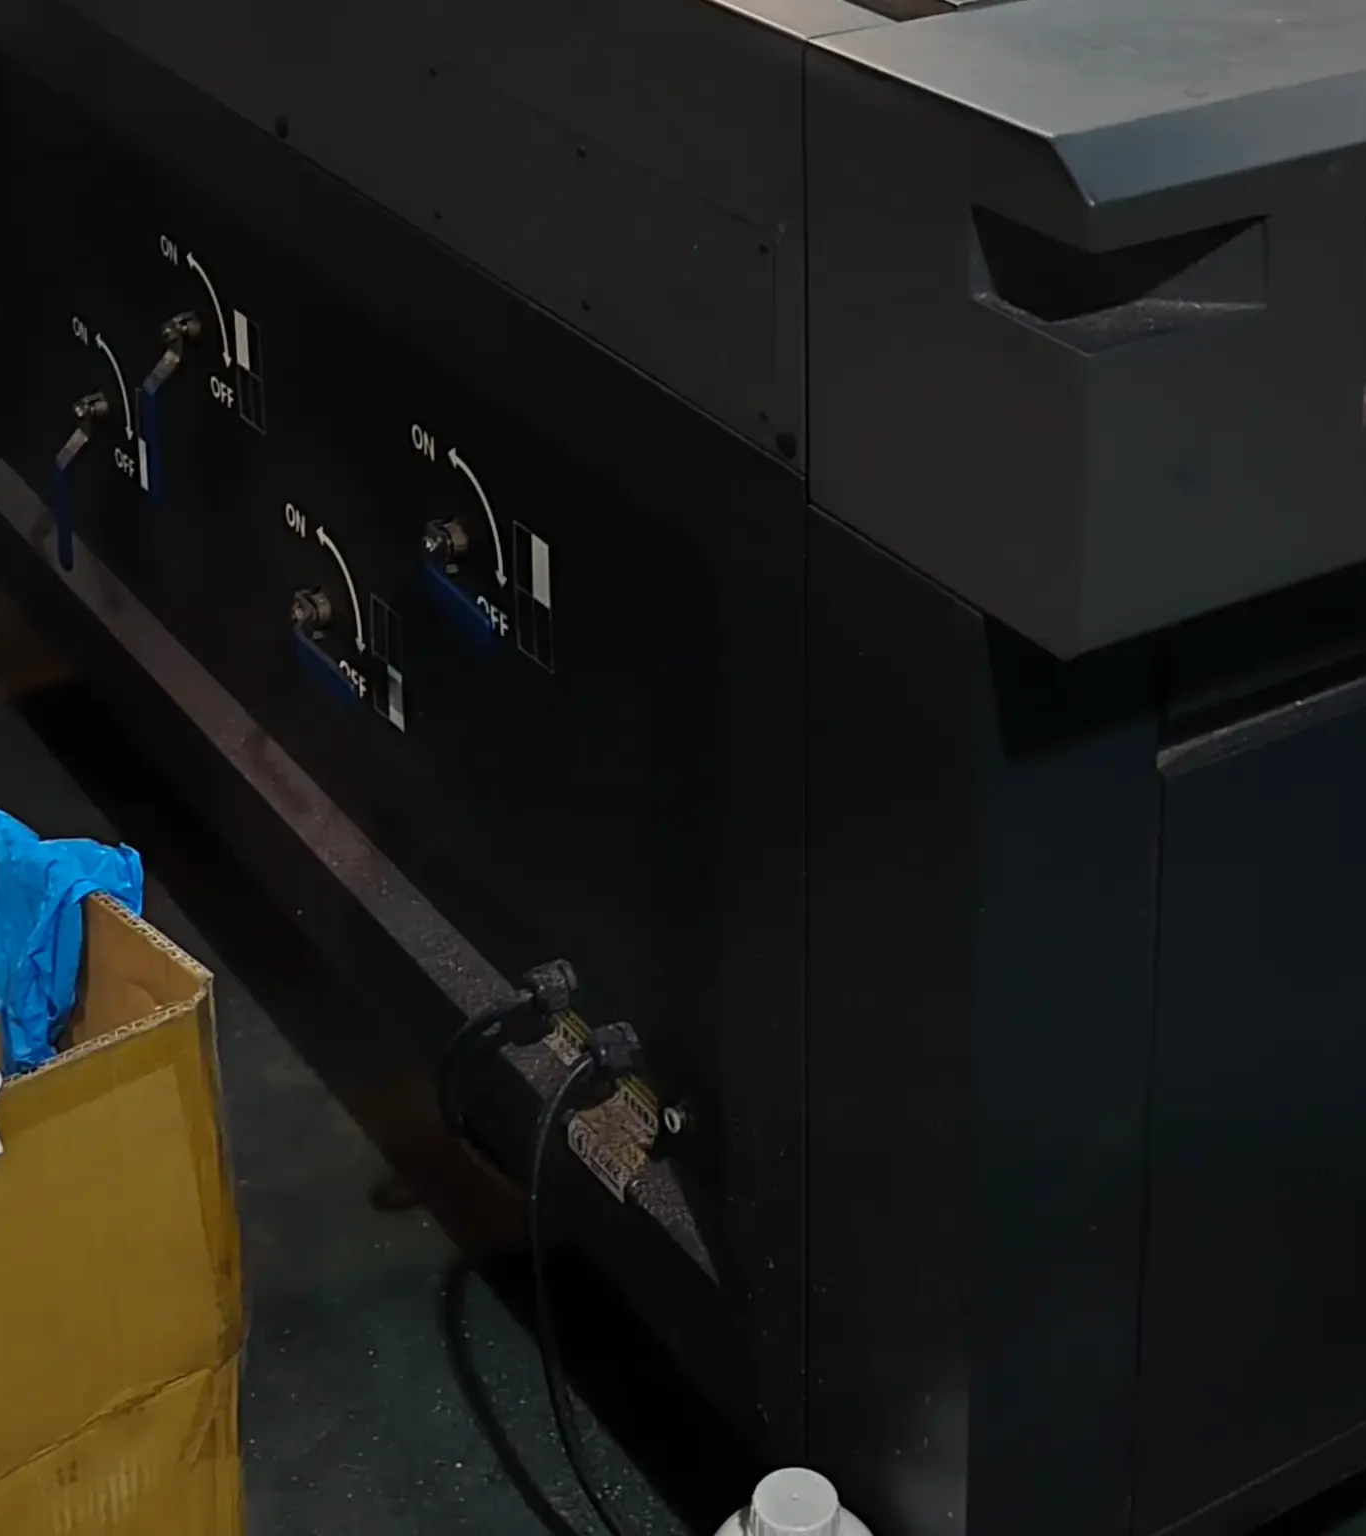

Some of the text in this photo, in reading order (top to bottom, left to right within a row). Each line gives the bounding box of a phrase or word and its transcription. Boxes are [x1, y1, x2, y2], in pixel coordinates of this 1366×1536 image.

[159, 235, 178, 265] ON
[72, 316, 88, 345] ON
[210, 375, 235, 409] OFF
[411, 423, 435, 462] ON
[114, 446, 135, 478] OFF
[285, 502, 306, 538] ON
